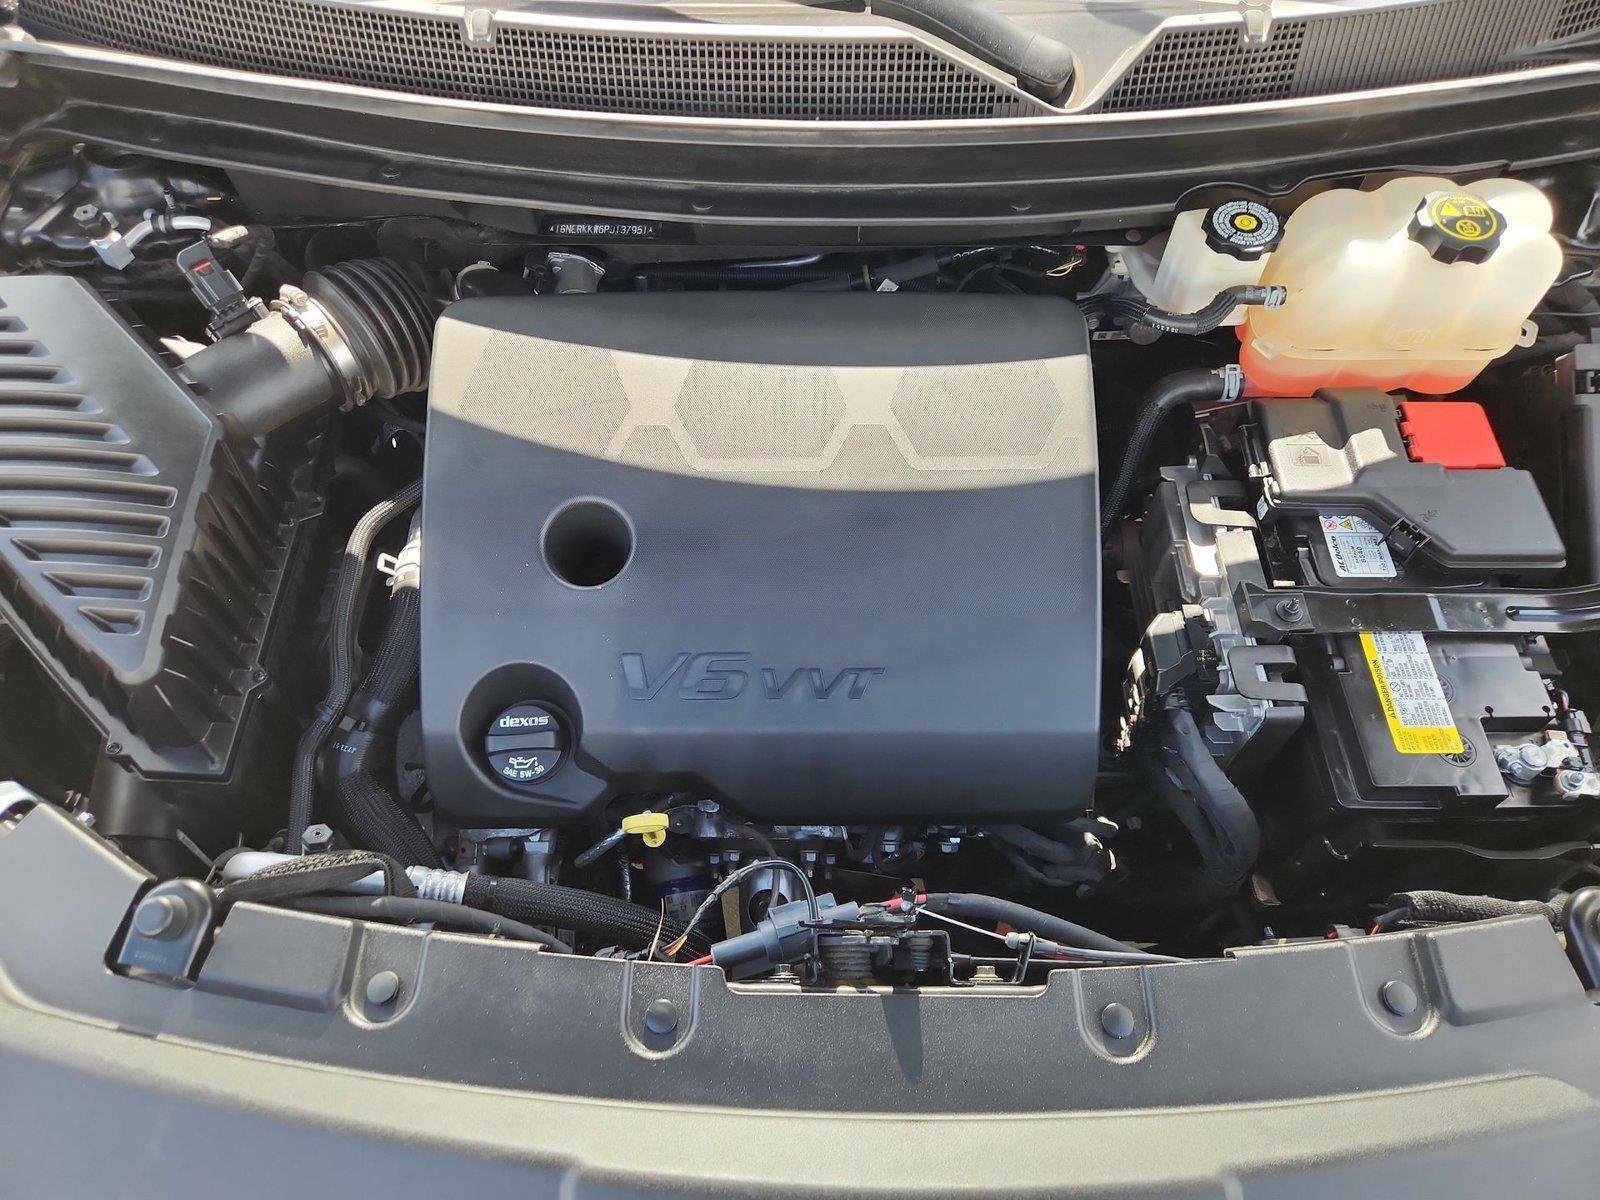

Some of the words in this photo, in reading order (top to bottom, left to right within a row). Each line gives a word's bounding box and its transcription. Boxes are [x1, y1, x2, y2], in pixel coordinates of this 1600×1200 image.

[620, 651, 752, 701] V6
[760, 666, 887, 700] VVT
[499, 715, 550, 728] dexos
[502, 765, 518, 779] SAE
[519, 764, 545, 779] 5W-30
